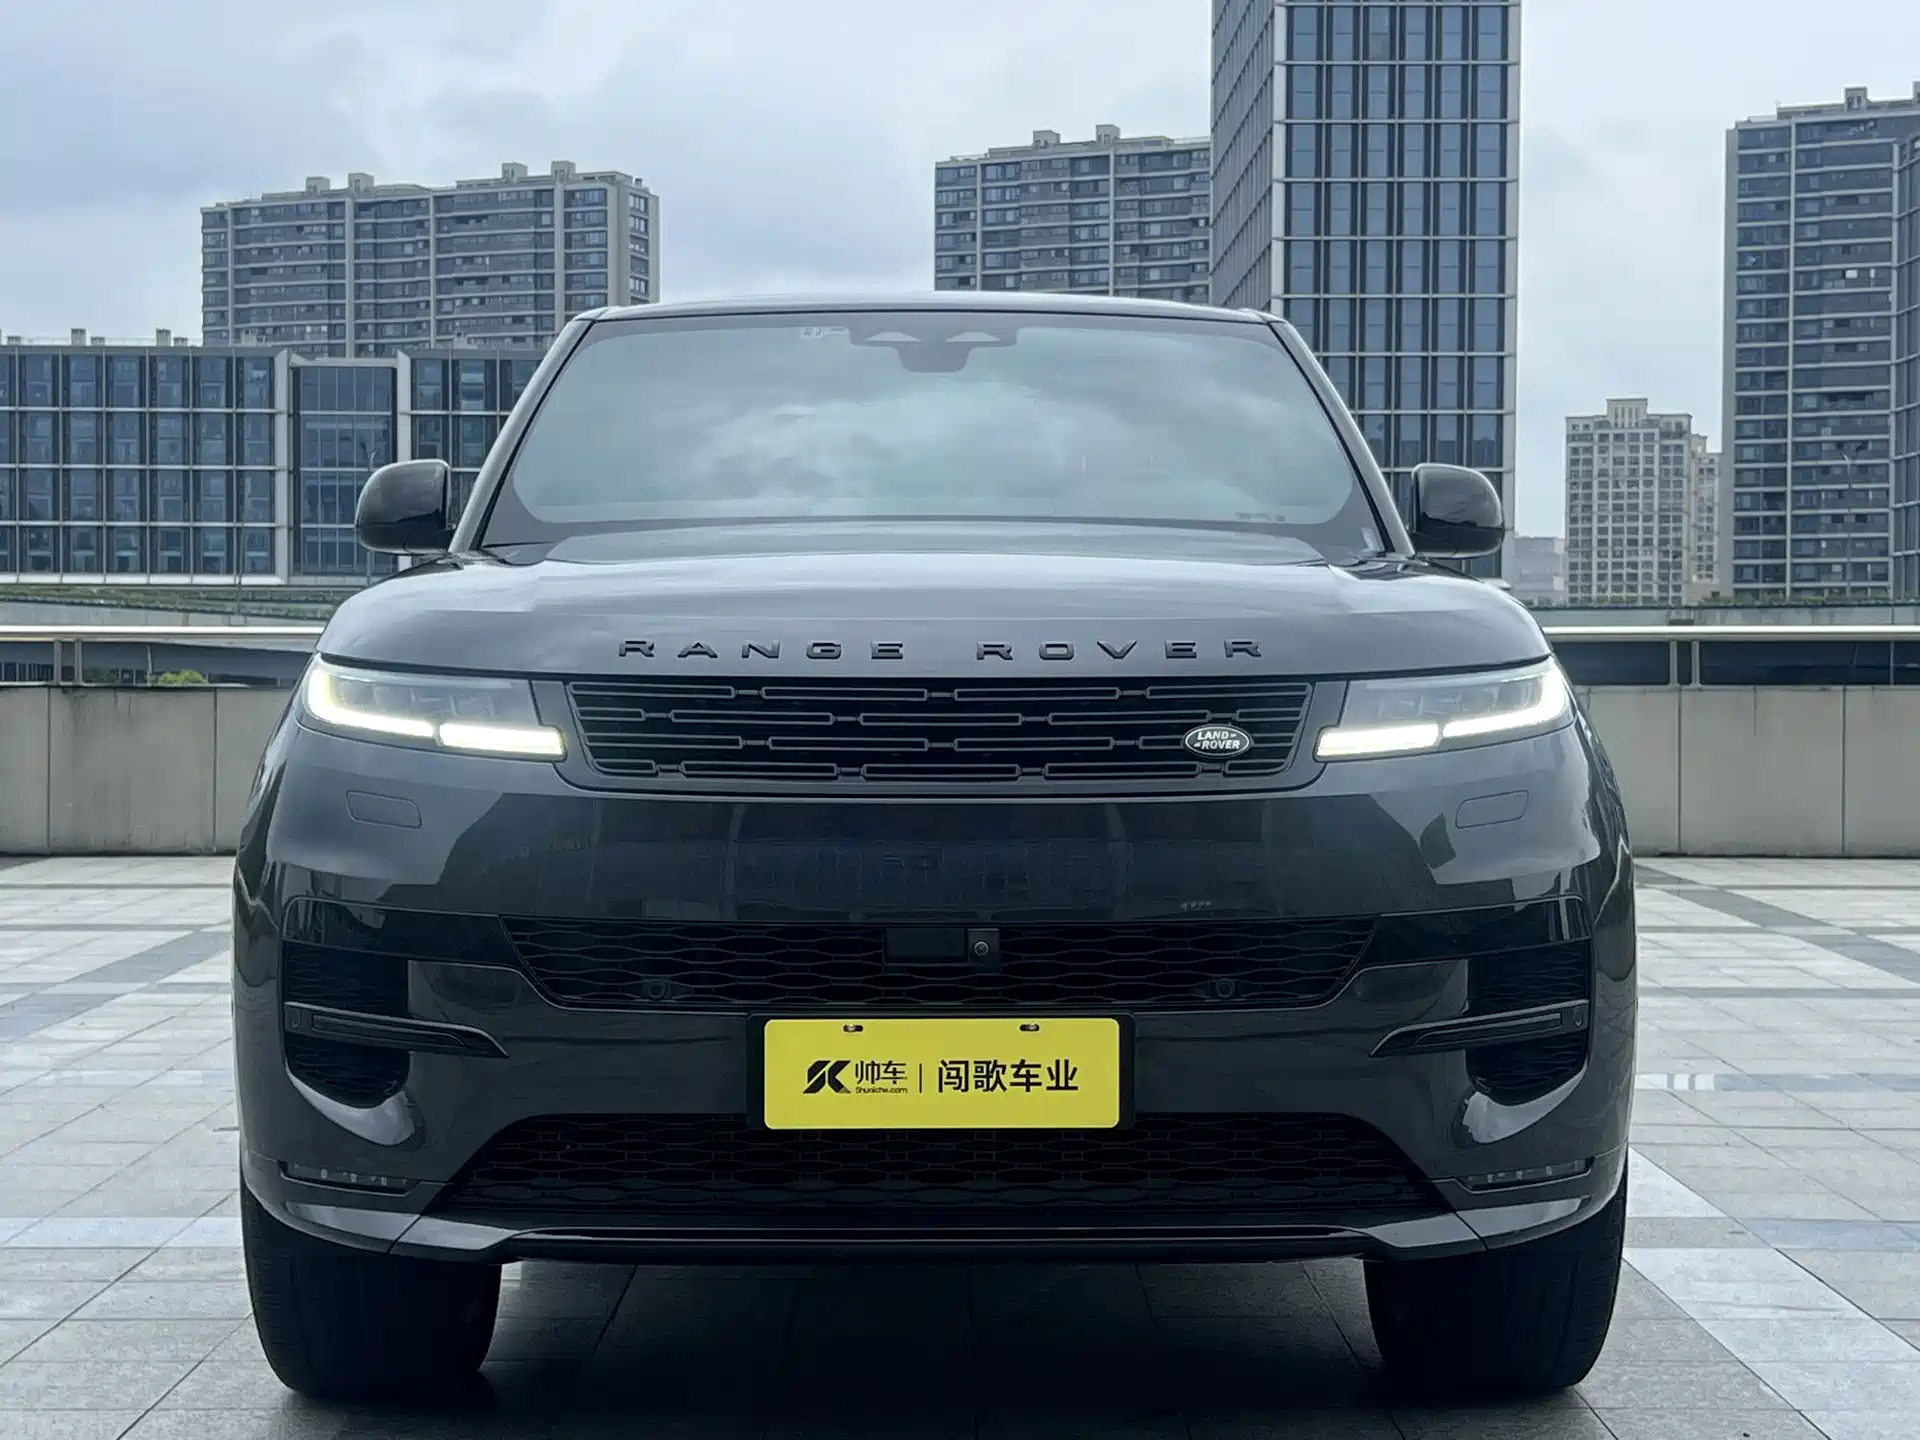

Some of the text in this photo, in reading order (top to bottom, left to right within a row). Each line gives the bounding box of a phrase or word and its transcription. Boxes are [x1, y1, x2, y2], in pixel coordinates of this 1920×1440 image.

[619, 639, 1263, 659] RANGE ROVER
[1197, 731, 1229, 740] LAND
[1201, 740, 1240, 750] ROVER
[855, 1060, 908, 1084] 帅车
[937, 1059, 1079, 1092] 闯歌车业
